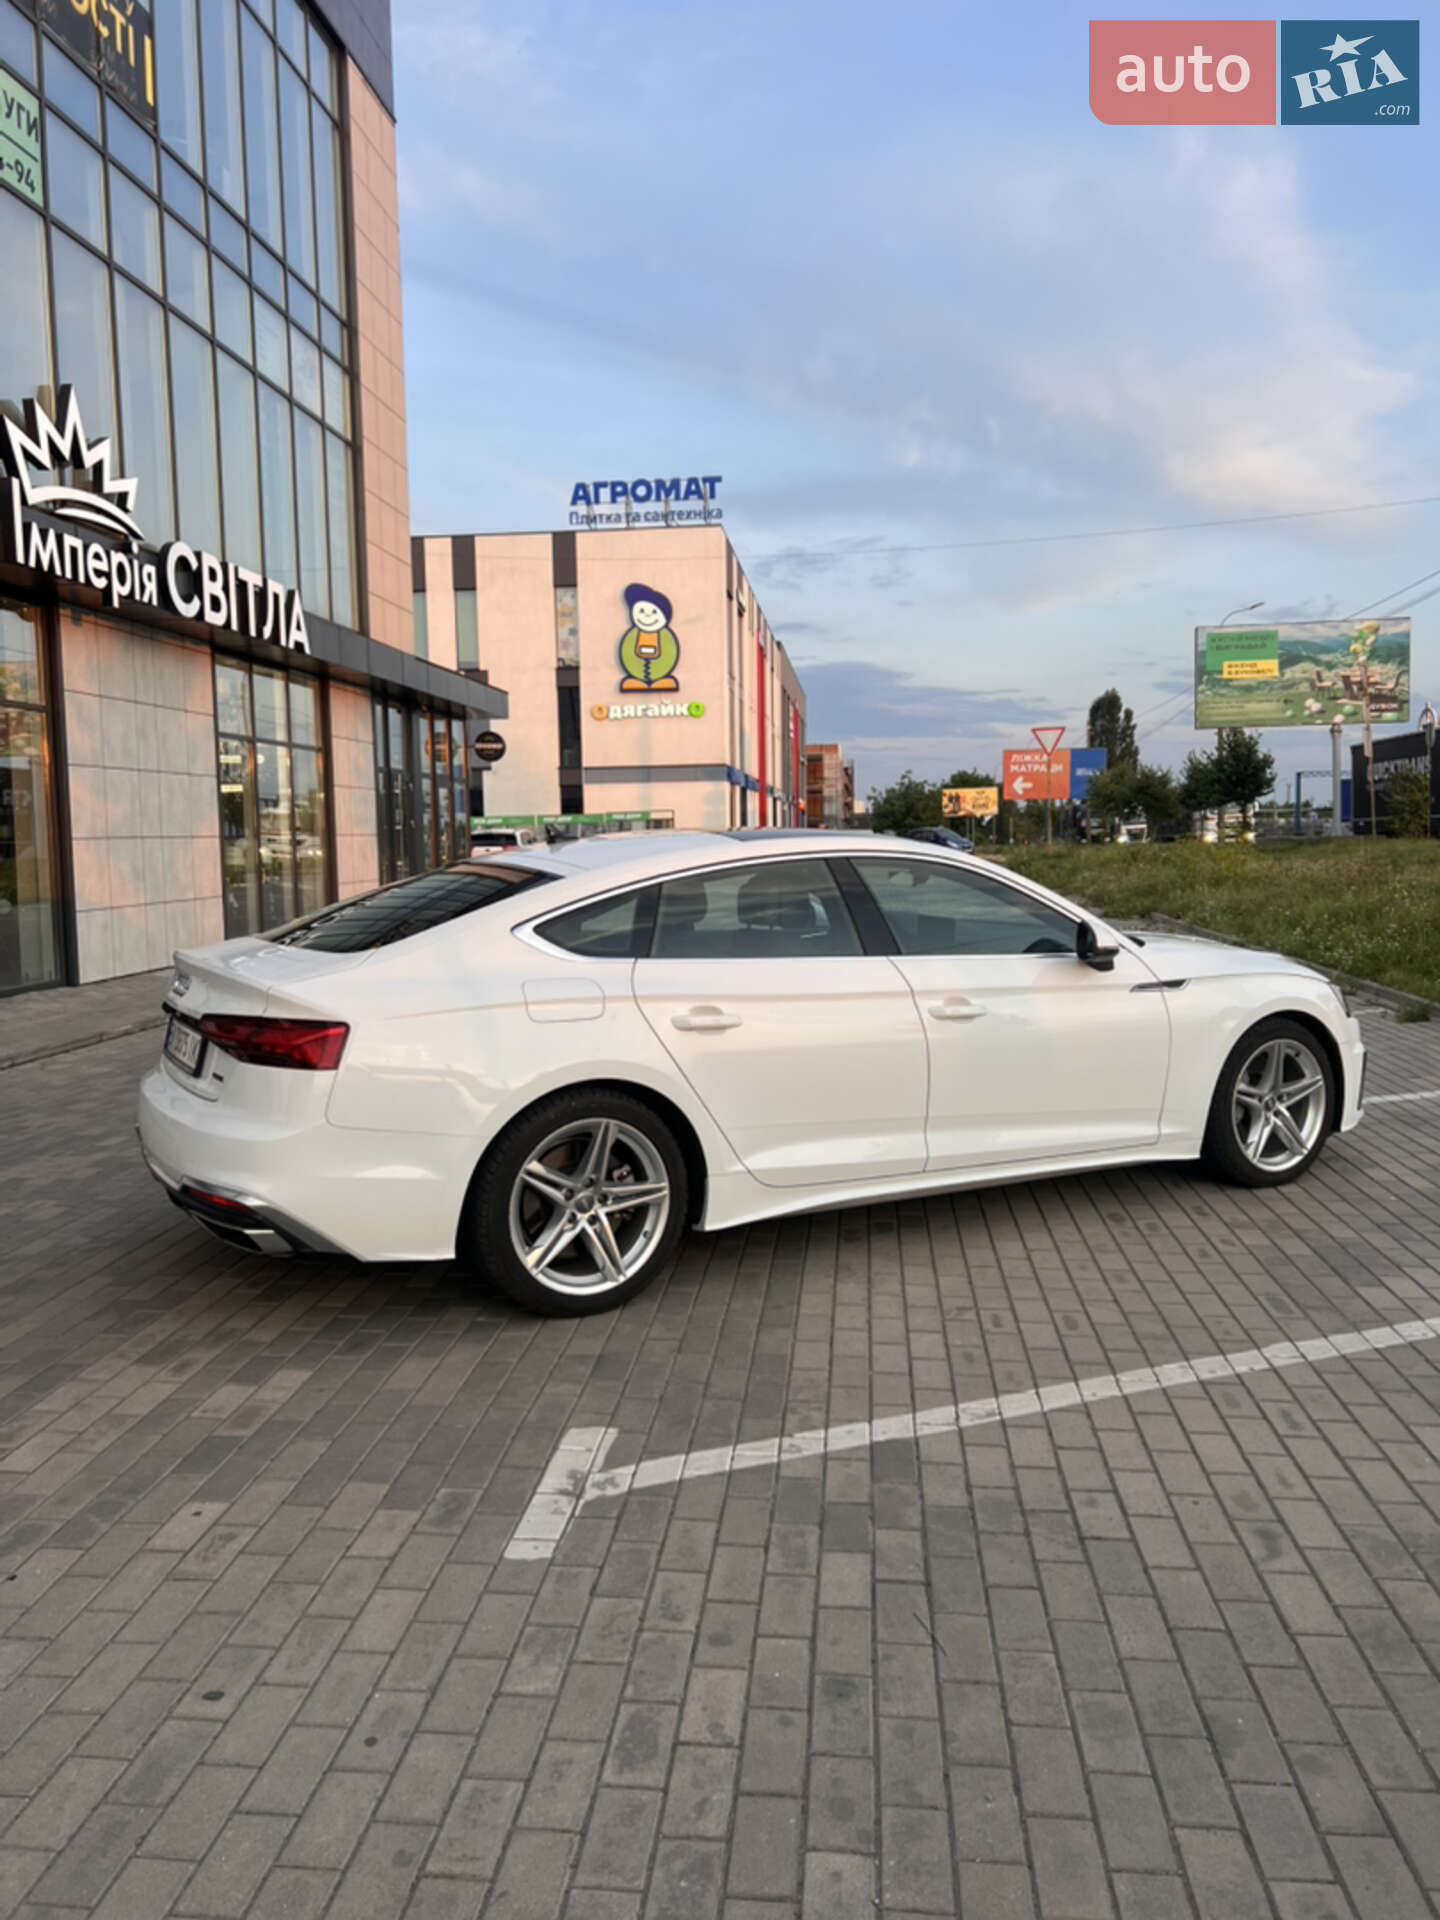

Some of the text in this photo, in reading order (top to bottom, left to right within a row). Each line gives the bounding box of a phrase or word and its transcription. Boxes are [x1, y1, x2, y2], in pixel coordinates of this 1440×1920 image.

[571, 475, 722, 505] АГРОМАТ
[569, 511, 621, 525] Плитка
[643, 507, 723, 522] сантехніка
[12, 477, 311, 654] Імперія СВІТЛА
